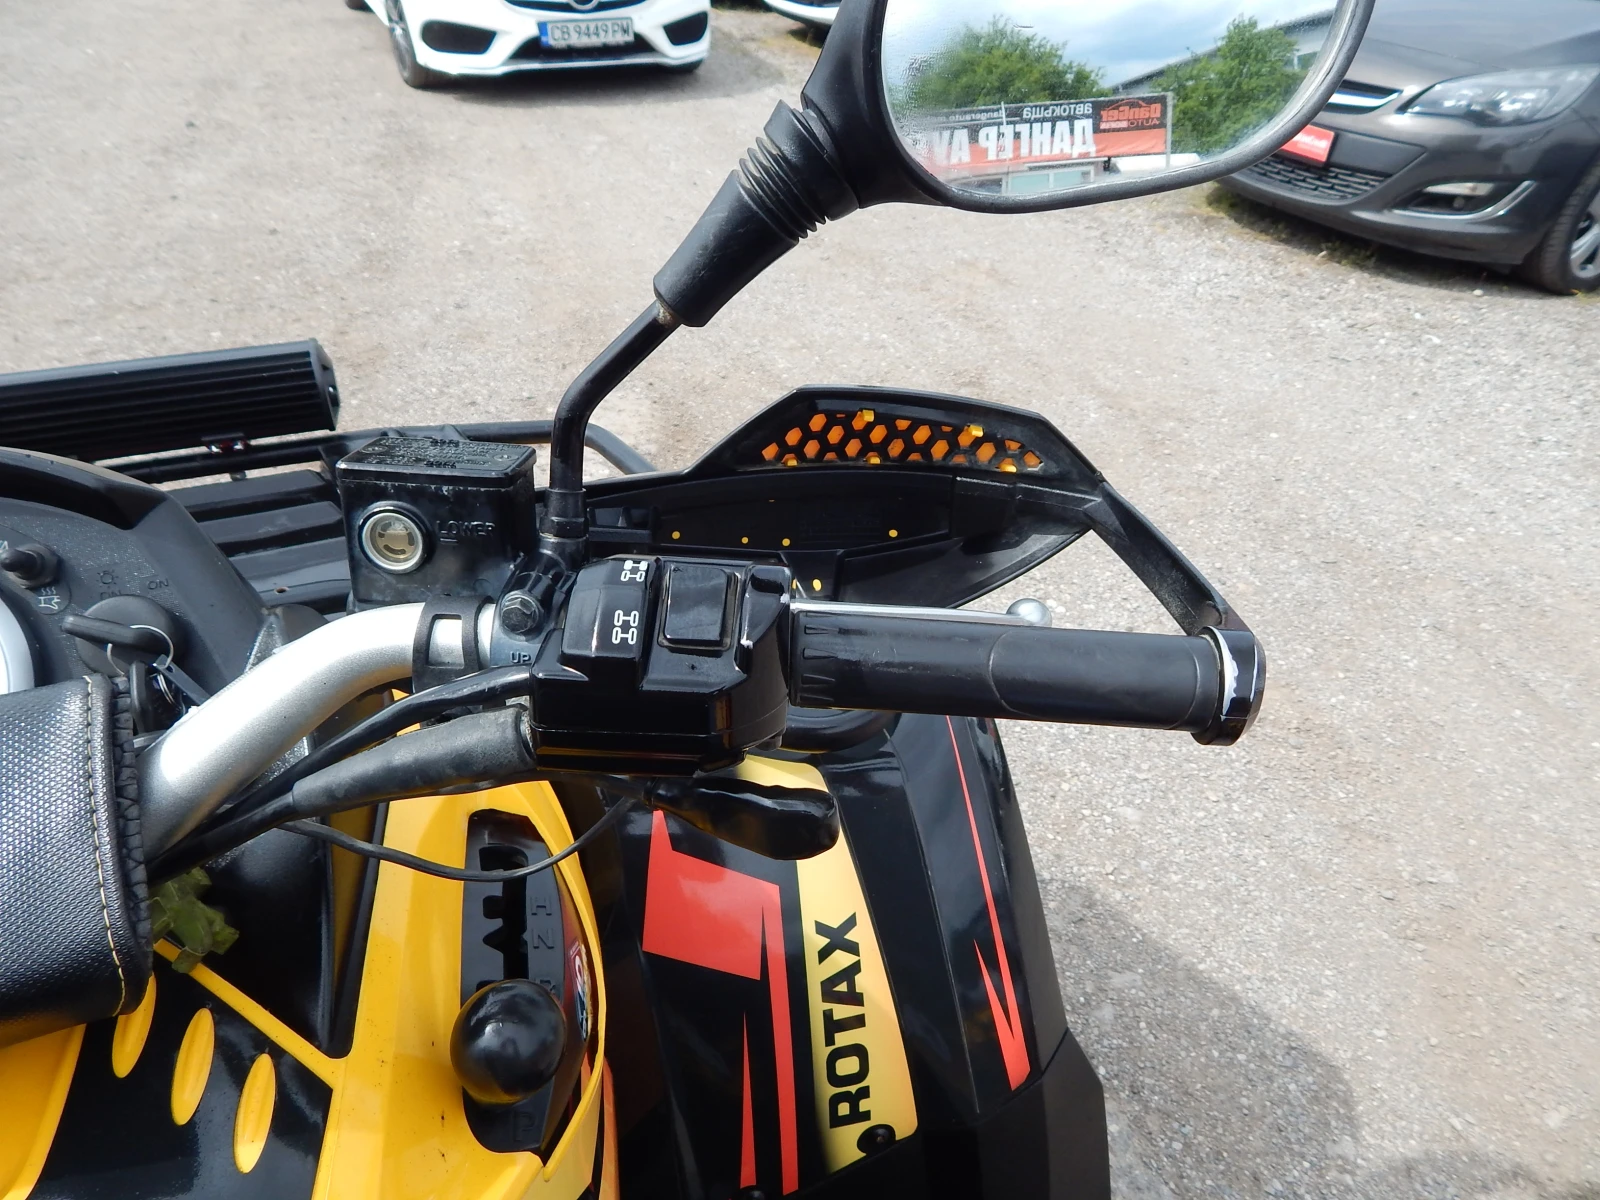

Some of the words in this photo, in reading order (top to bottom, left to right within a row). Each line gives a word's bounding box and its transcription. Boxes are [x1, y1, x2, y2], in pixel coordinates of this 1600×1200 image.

[437, 520, 496, 537] LOWER
[147, 578, 169, 590] ON
[510, 651, 532, 665] UP
[530, 895, 553, 916] H
[531, 927, 555, 949] N
[814, 911, 872, 1129] ROTAX
[512, 1110, 538, 1142] P
